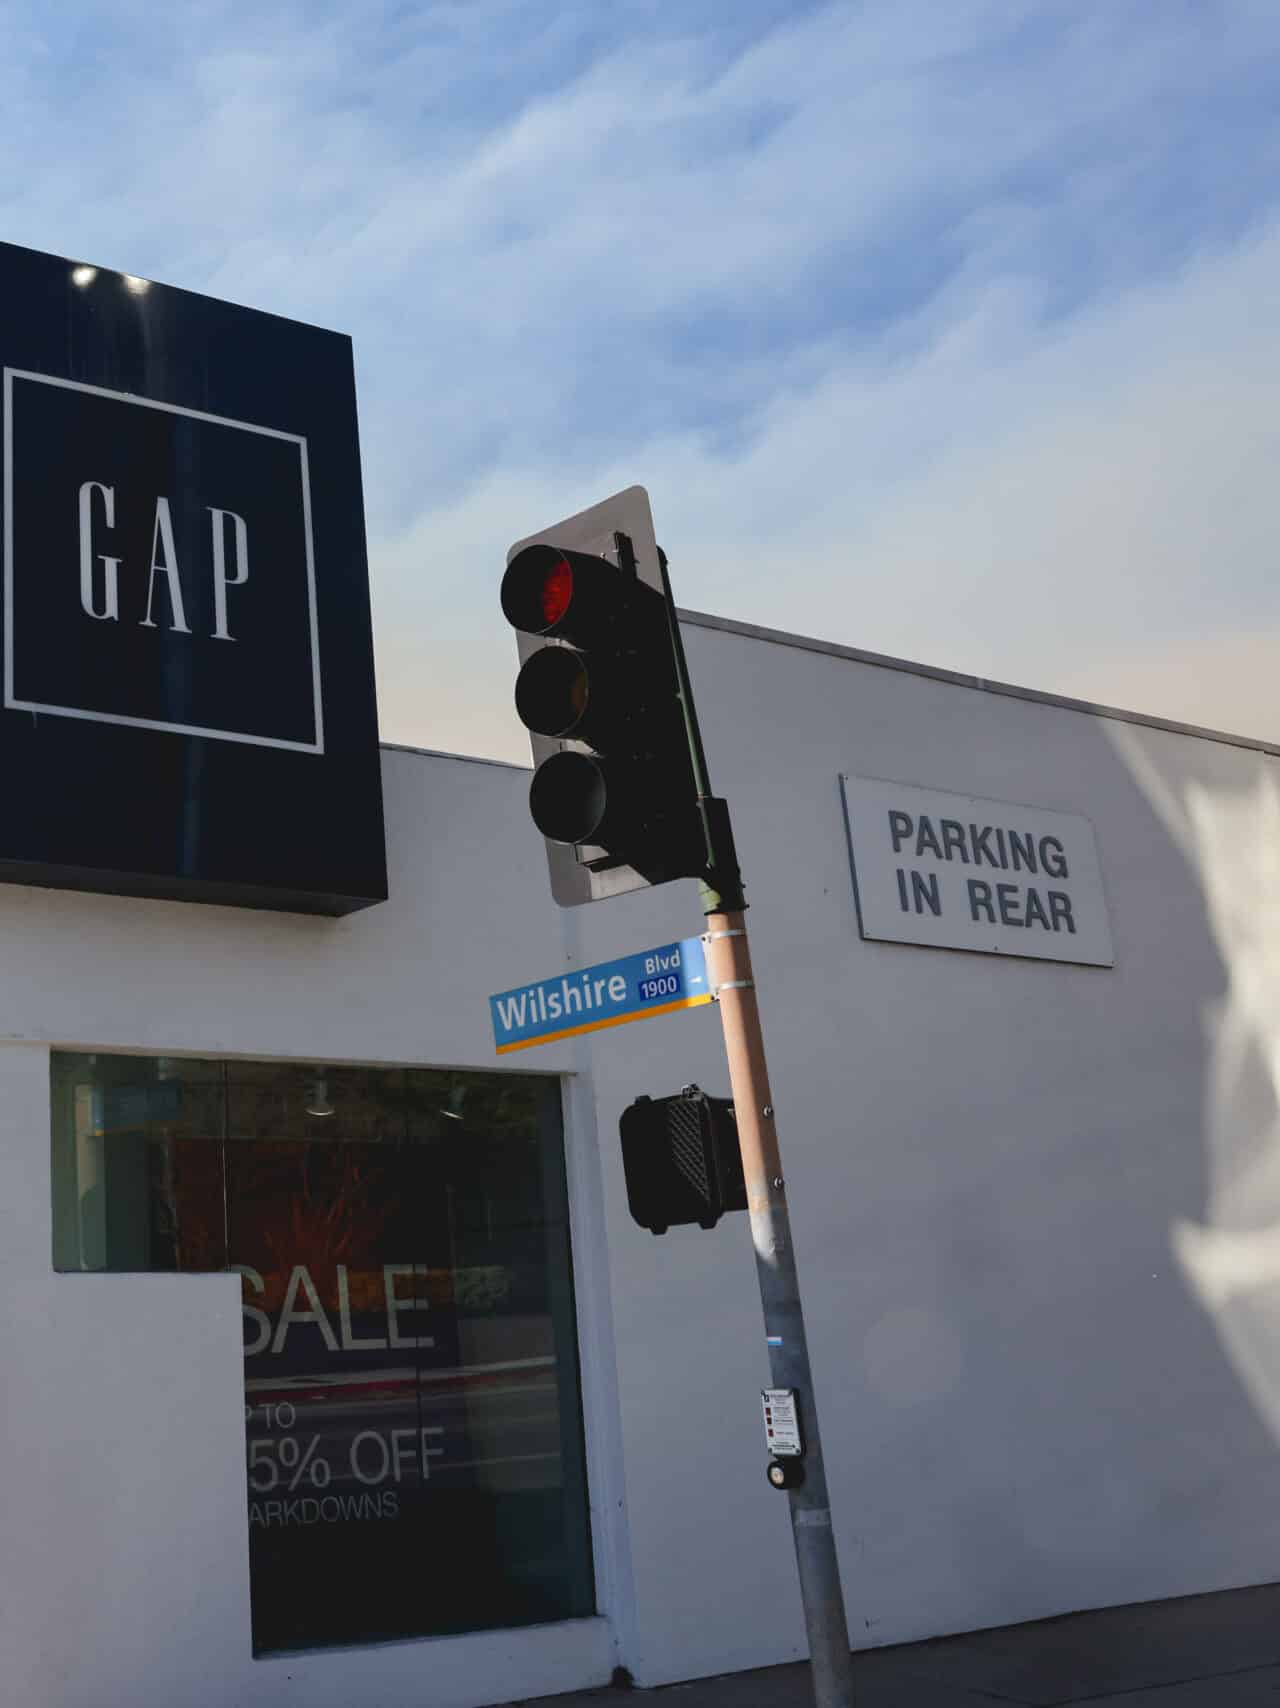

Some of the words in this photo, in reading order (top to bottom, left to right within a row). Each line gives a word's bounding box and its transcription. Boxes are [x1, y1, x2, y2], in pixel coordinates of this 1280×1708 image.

[79, 481, 249, 642] GAP
[888, 809, 1069, 879] PARKING
[896, 868, 942, 917] IN
[967, 878, 1077, 934] REAR
[497, 974, 627, 1031] Wilshire
[645, 950, 681, 975] Blvd
[641, 976, 678, 1000] 1900
[228, 1263, 436, 1356] SALE
[257, 1401, 297, 1430] TO
[248, 1434, 331, 1493] 5%
[349, 1426, 445, 1485] OFF
[249, 1490, 401, 1529] ARKDOWNS
